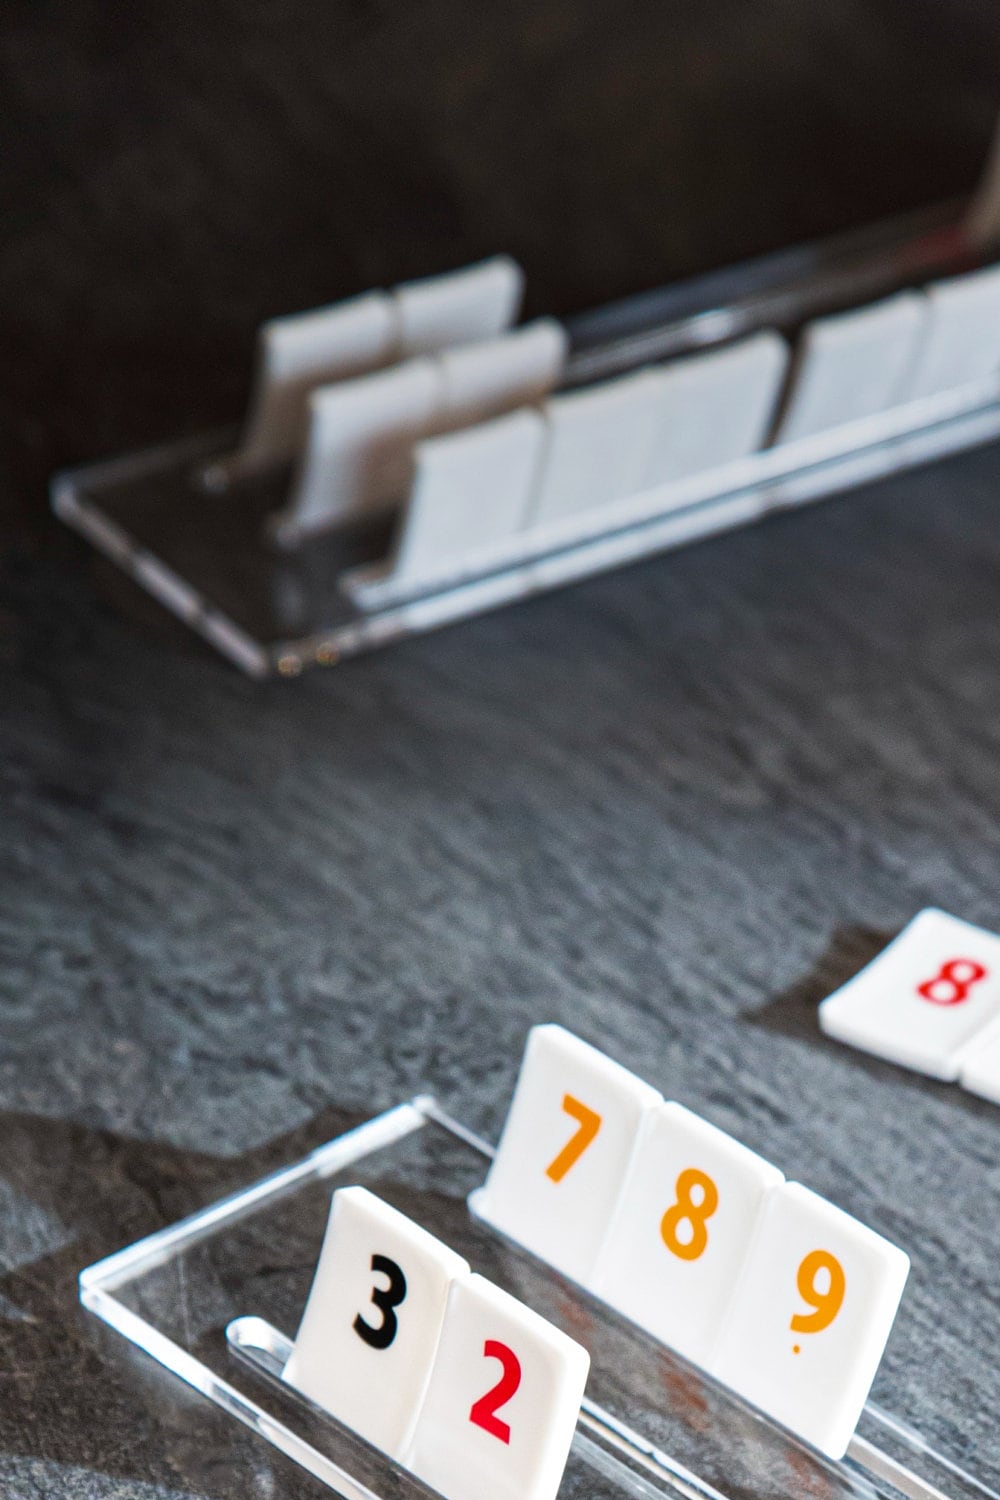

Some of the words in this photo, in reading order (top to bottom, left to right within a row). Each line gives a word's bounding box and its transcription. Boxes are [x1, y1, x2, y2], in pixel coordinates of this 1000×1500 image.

[915, 958, 989, 1007] 8
[544, 1092, 603, 1185] 7
[659, 1167, 720, 1263] 8
[789, 1248, 847, 1336] 9
[353, 1253, 408, 1351] 3
[468, 1338, 523, 1446] 2
